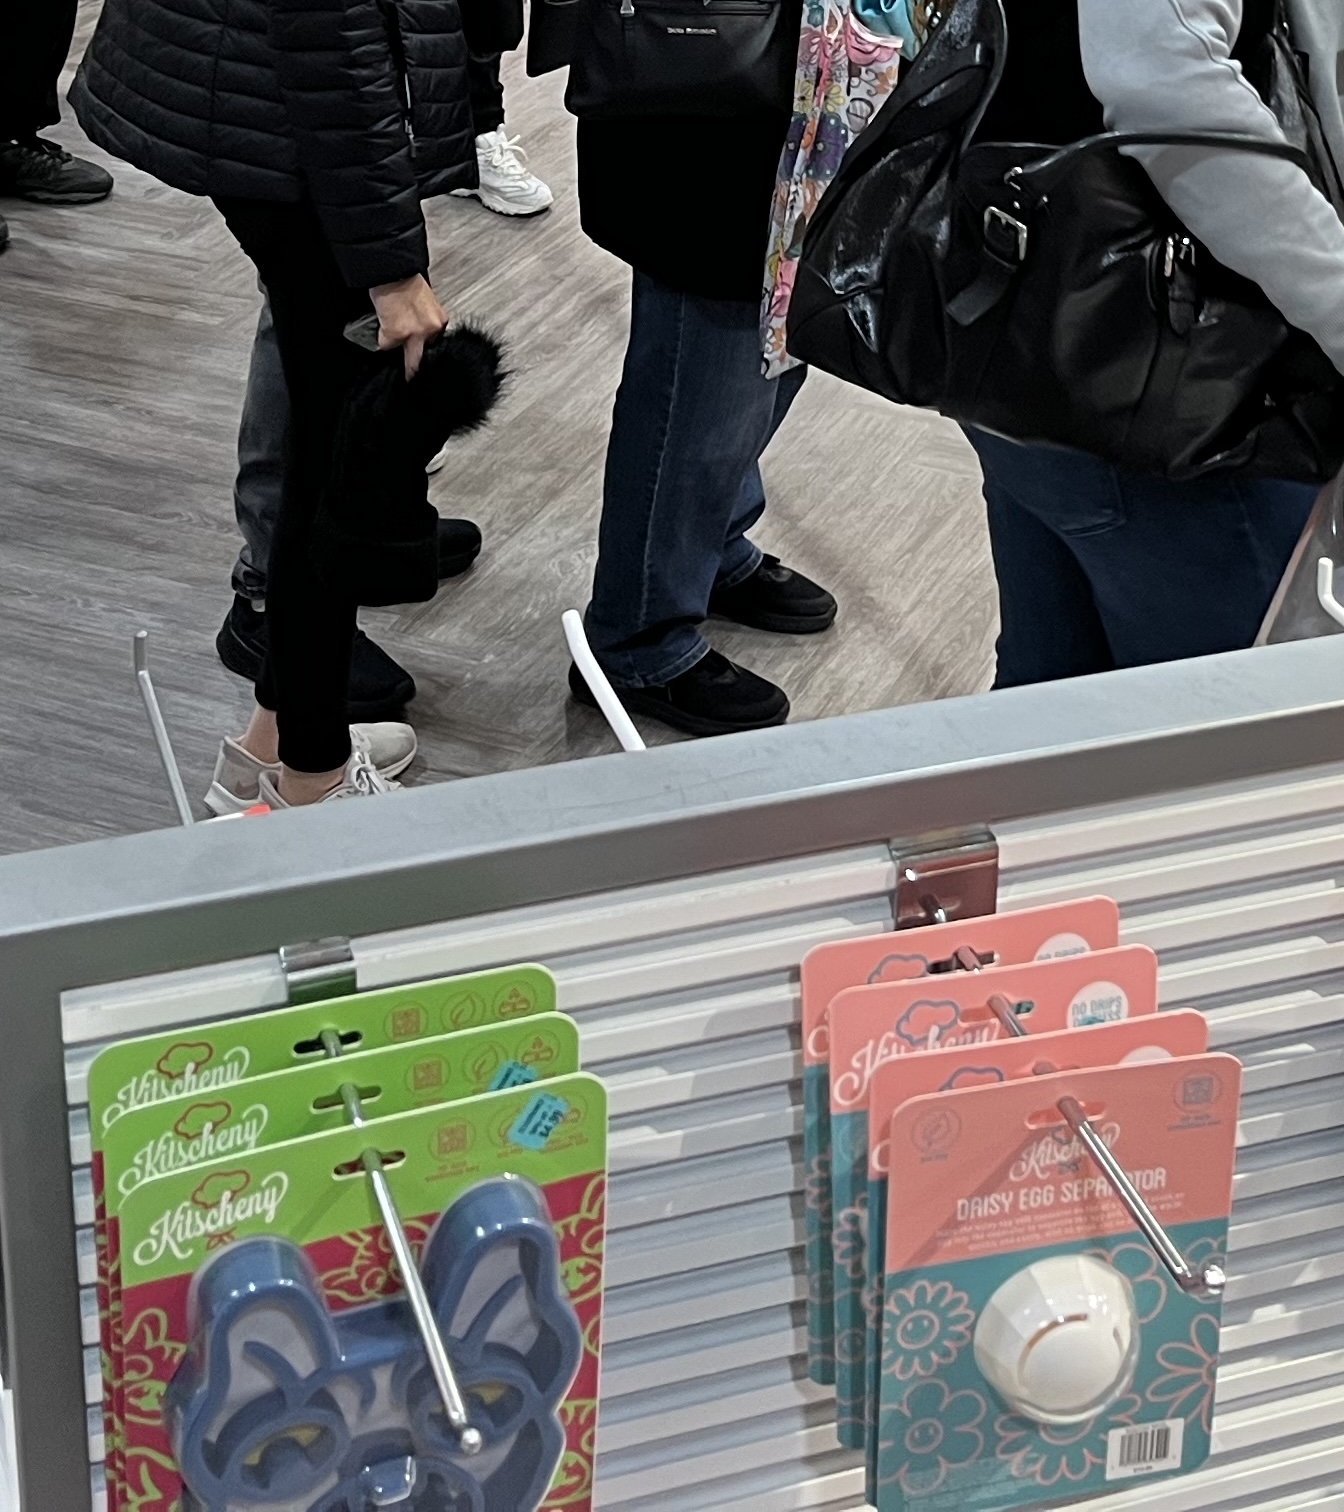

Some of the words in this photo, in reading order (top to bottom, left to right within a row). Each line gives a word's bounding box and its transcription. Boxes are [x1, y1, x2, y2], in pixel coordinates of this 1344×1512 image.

[1071, 999, 1087, 1016] NO
[102, 1045, 251, 1130] Kitscheny
[117, 1103, 269, 1196] Kitscheny
[132, 1170, 289, 1267] Kitscheny
[956, 1192, 1014, 1221] DAISY
[1019, 1185, 1054, 1209] EGG
